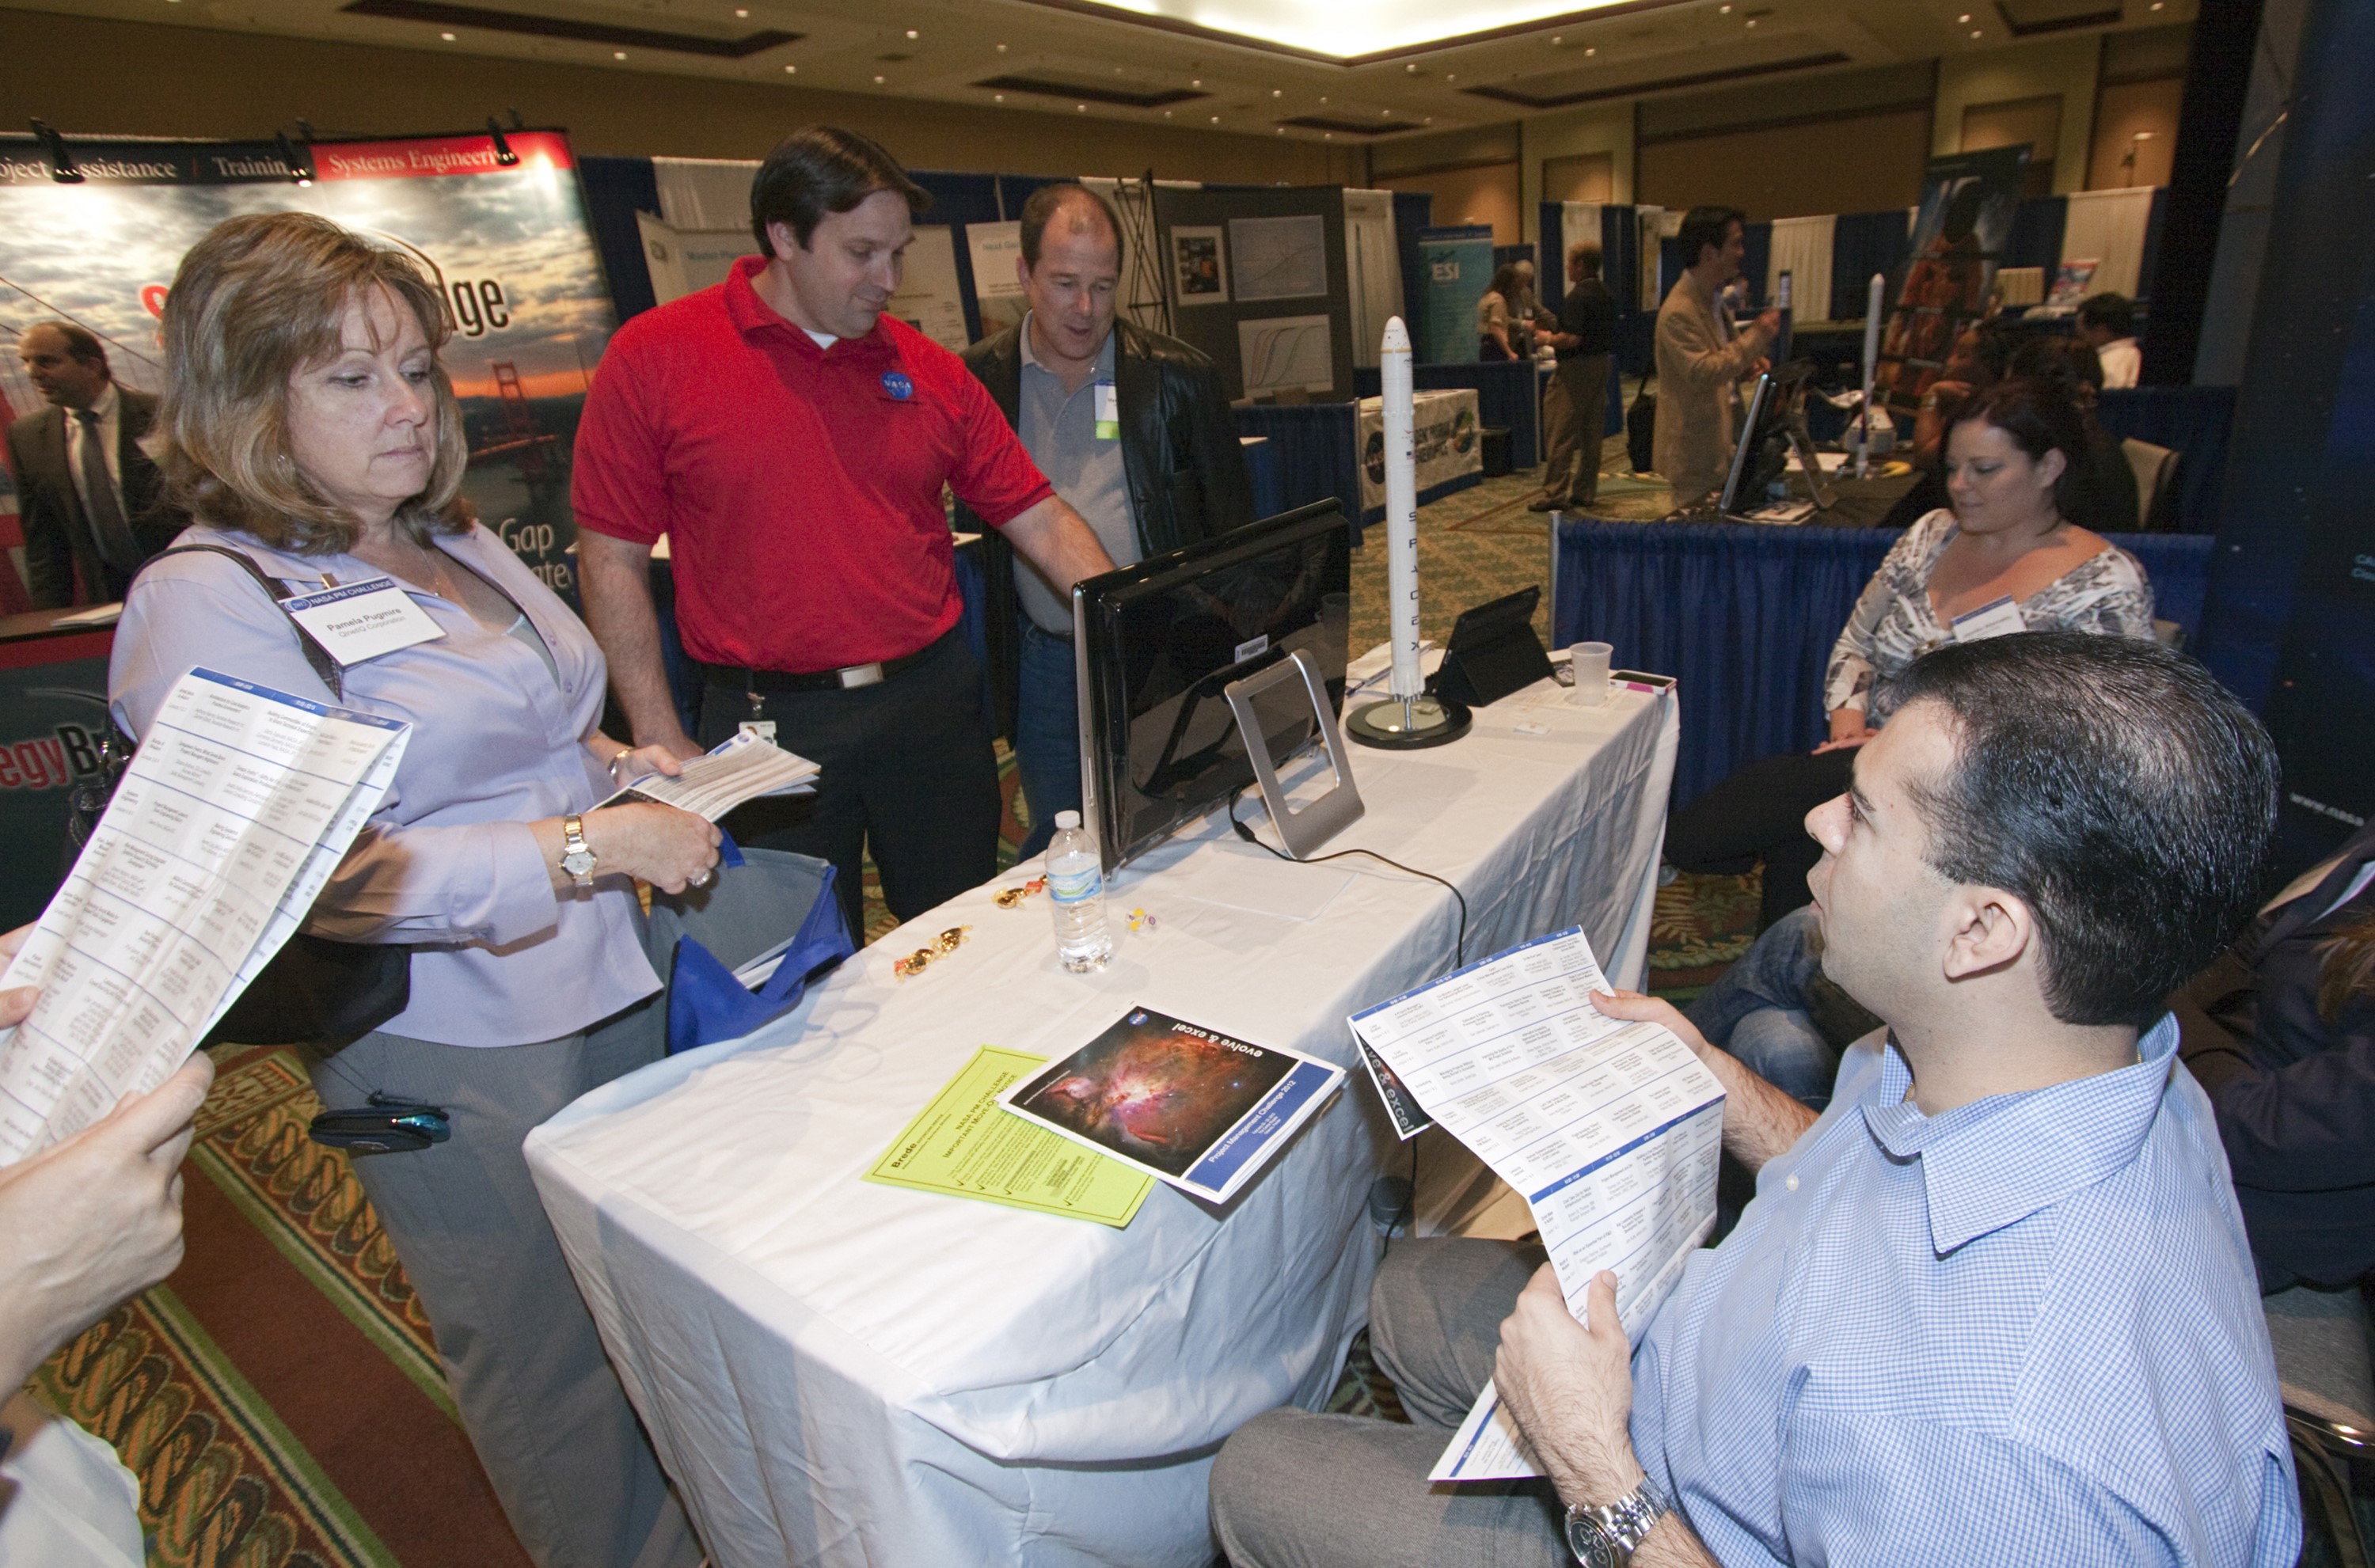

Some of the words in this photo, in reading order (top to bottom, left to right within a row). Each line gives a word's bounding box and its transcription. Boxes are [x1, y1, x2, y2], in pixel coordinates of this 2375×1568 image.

[78, 157, 177, 177] ssistance
[211, 156, 291, 177] Trainin
[329, 154, 405, 177] Systems
[408, 144, 500, 173] Engineeri
[1431, 262, 1460, 280] ESI
[499, 517, 553, 559] Gap
[310, 594, 335, 605] NASA
[334, 590, 348, 600] PM
[348, 580, 393, 596] CHALLENGE
[326, 617, 364, 632] Pamela
[363, 607, 402, 624] Pugmire
[367, 615, 406, 630] Corporation
[1172, 1023, 1207, 1039] excel
[1208, 1035, 1220, 1043] &
[1221, 1038, 1264, 1058] evolve
[956, 1114, 973, 1130] NASA
[971, 1103, 982, 1117] PM
[978, 1071, 1009, 1104] CHALLENGE
[1378, 1072, 1391, 1085] &
[1385, 1088, 1415, 1133] excel
[943, 1126, 975, 1158] IMPORTANT
[973, 1097, 995, 1126] MOVE-O
[997, 1074, 1017, 1094] NOTICE
[1208, 1143, 1231, 1163] Project
[1226, 1115, 1262, 1145] Management
[1257, 1092, 1284, 1116] Challenge
[1281, 1080, 1297, 1093] 2012
[891, 1143, 918, 1168] Brede
